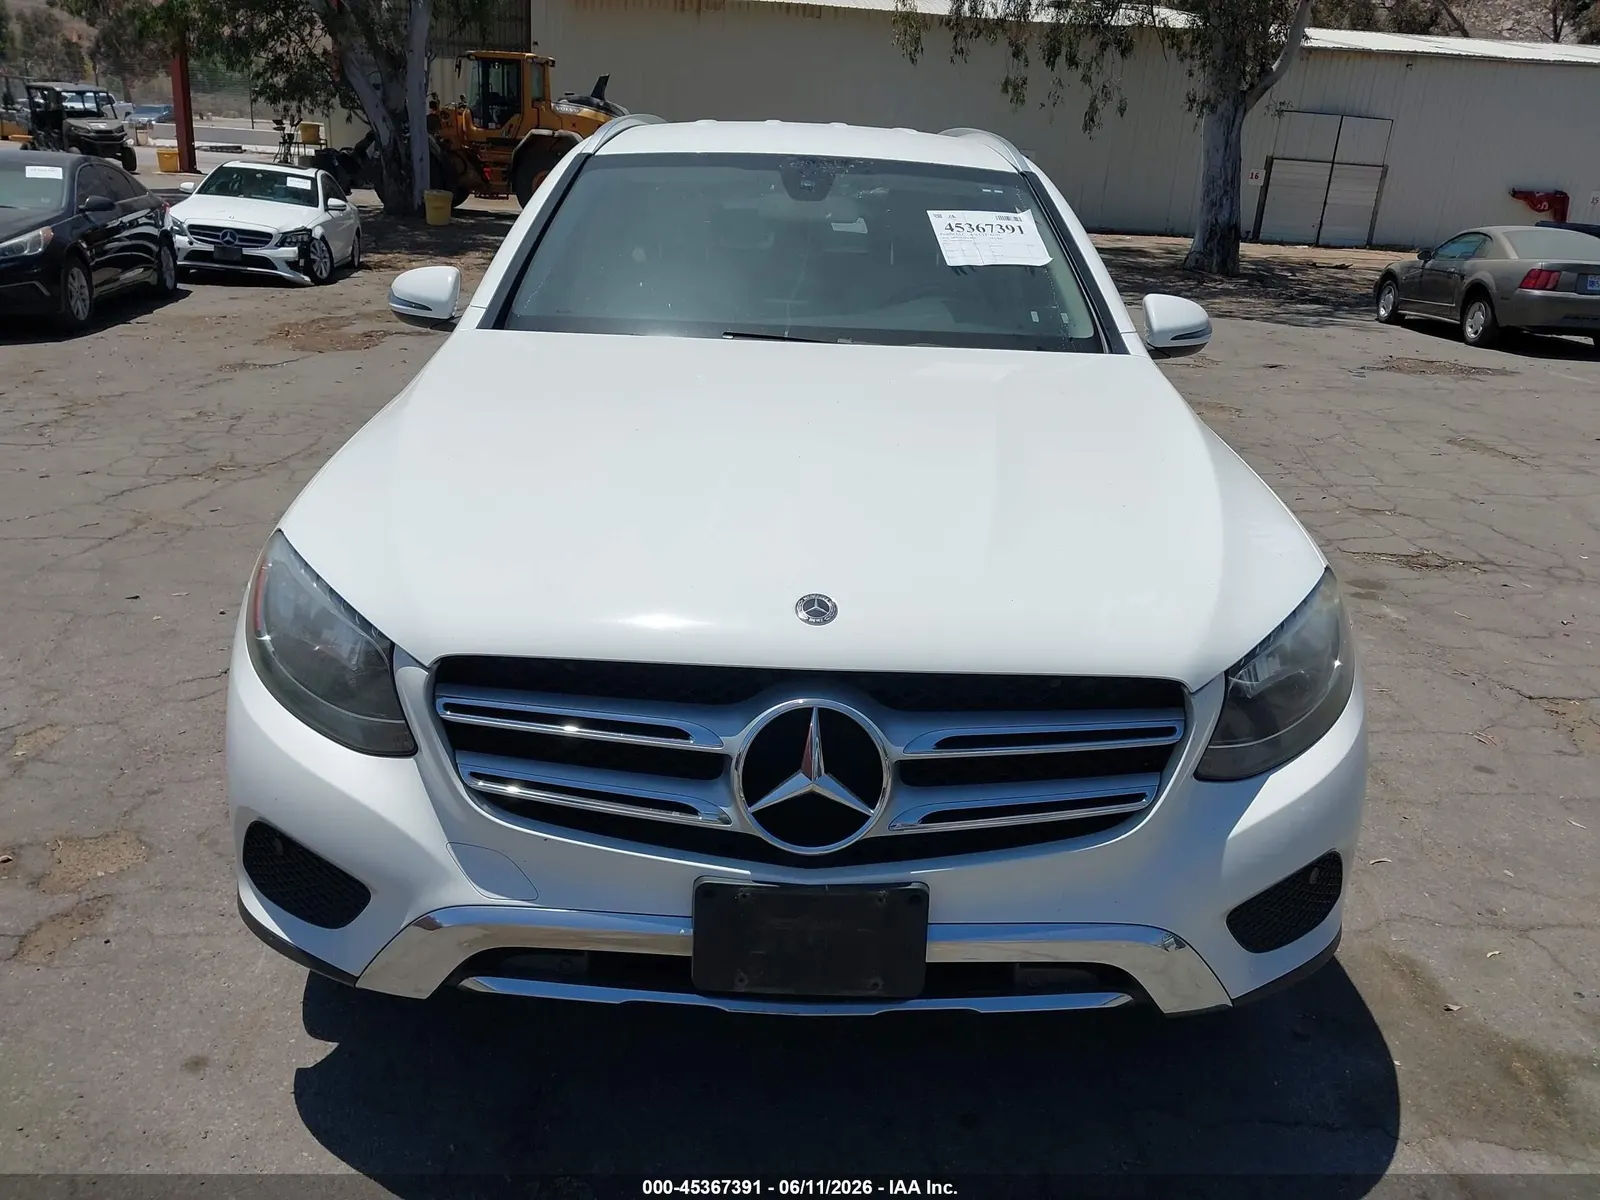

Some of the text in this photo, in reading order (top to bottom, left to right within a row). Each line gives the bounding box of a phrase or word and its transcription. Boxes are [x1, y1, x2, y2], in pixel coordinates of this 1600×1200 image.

[556, 105, 580, 113] VOLVO
[1249, 171, 1259, 180] 16
[944, 222, 1024, 235] 45367391
